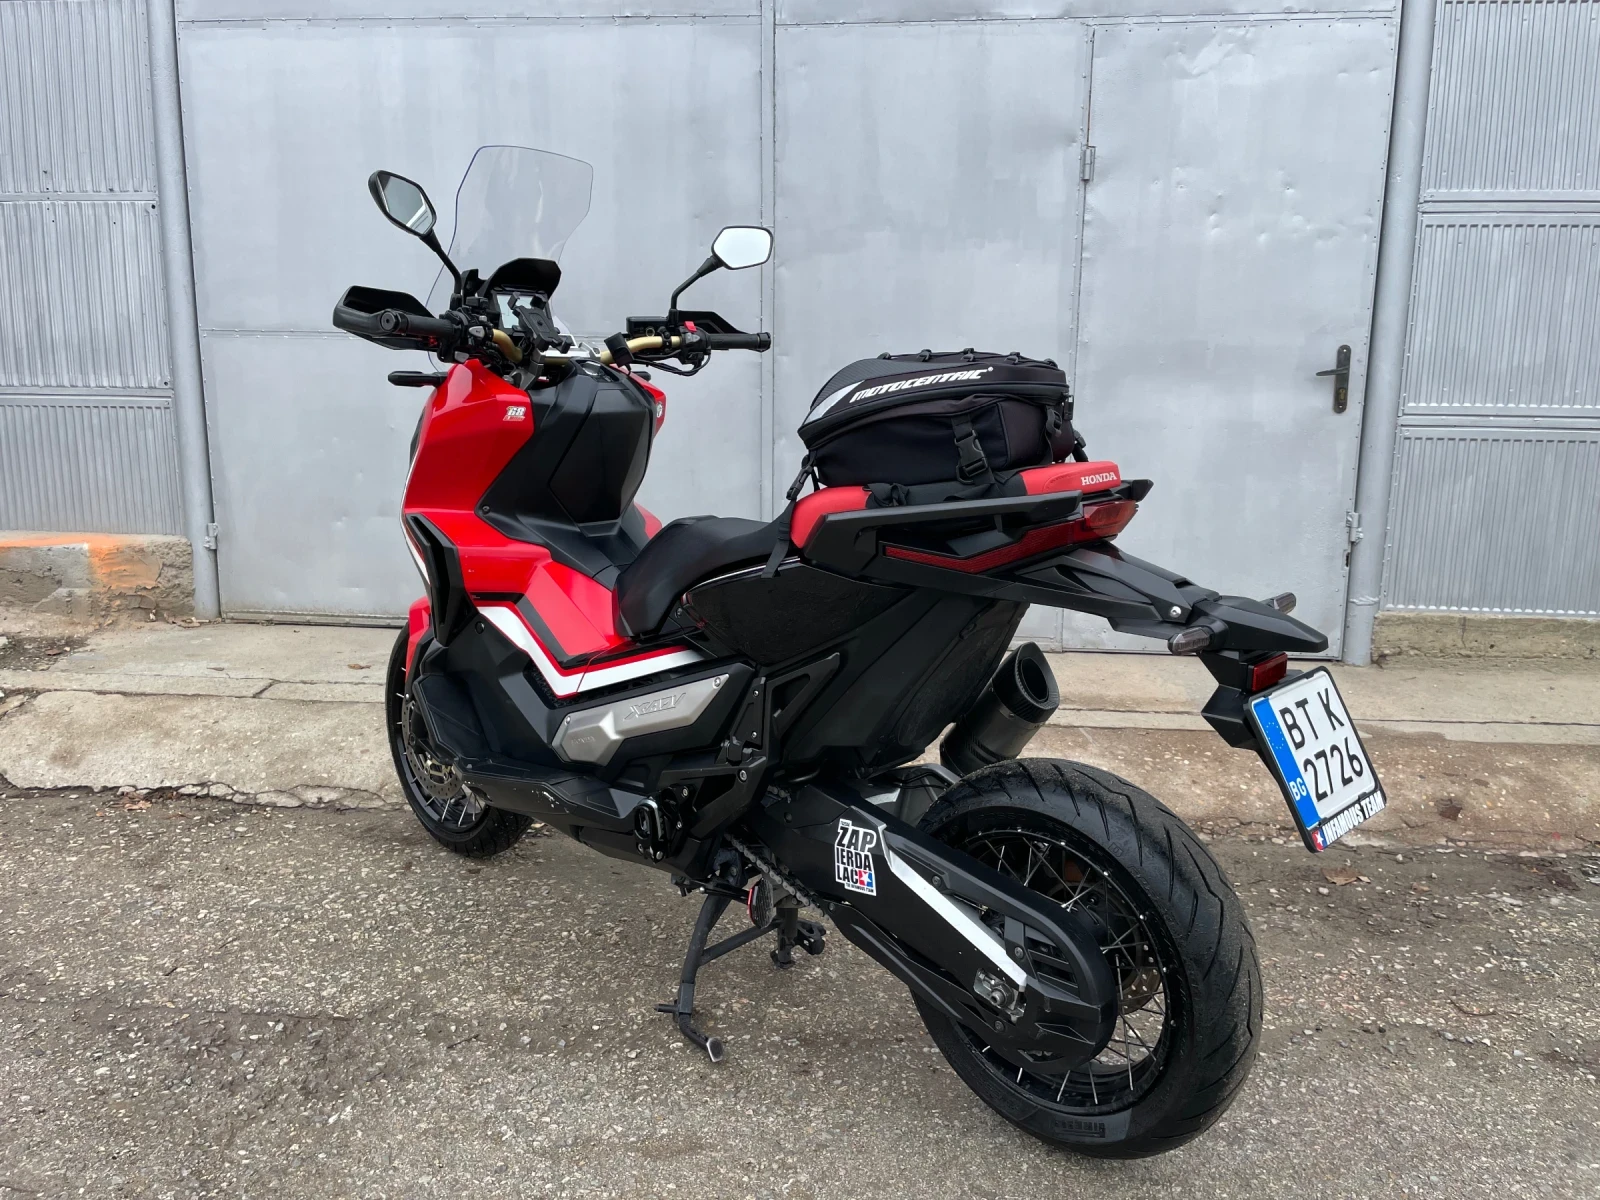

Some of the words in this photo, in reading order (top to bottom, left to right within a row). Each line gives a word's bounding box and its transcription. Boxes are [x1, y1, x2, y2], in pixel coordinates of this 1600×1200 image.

[849, 369, 988, 403] MOTOCENTRIC
[1080, 471, 1118, 486] HONDA
[1278, 697, 1319, 750] BT
[1316, 687, 1345, 731] K
[1303, 736, 1364, 803] 2726
[1289, 777, 1307, 801] BG
[1321, 803, 1364, 845] INFAMOUS
[1360, 790, 1386, 819] TEAM
[836, 826, 875, 853] ZAP
[836, 847, 872, 872] IERDA
